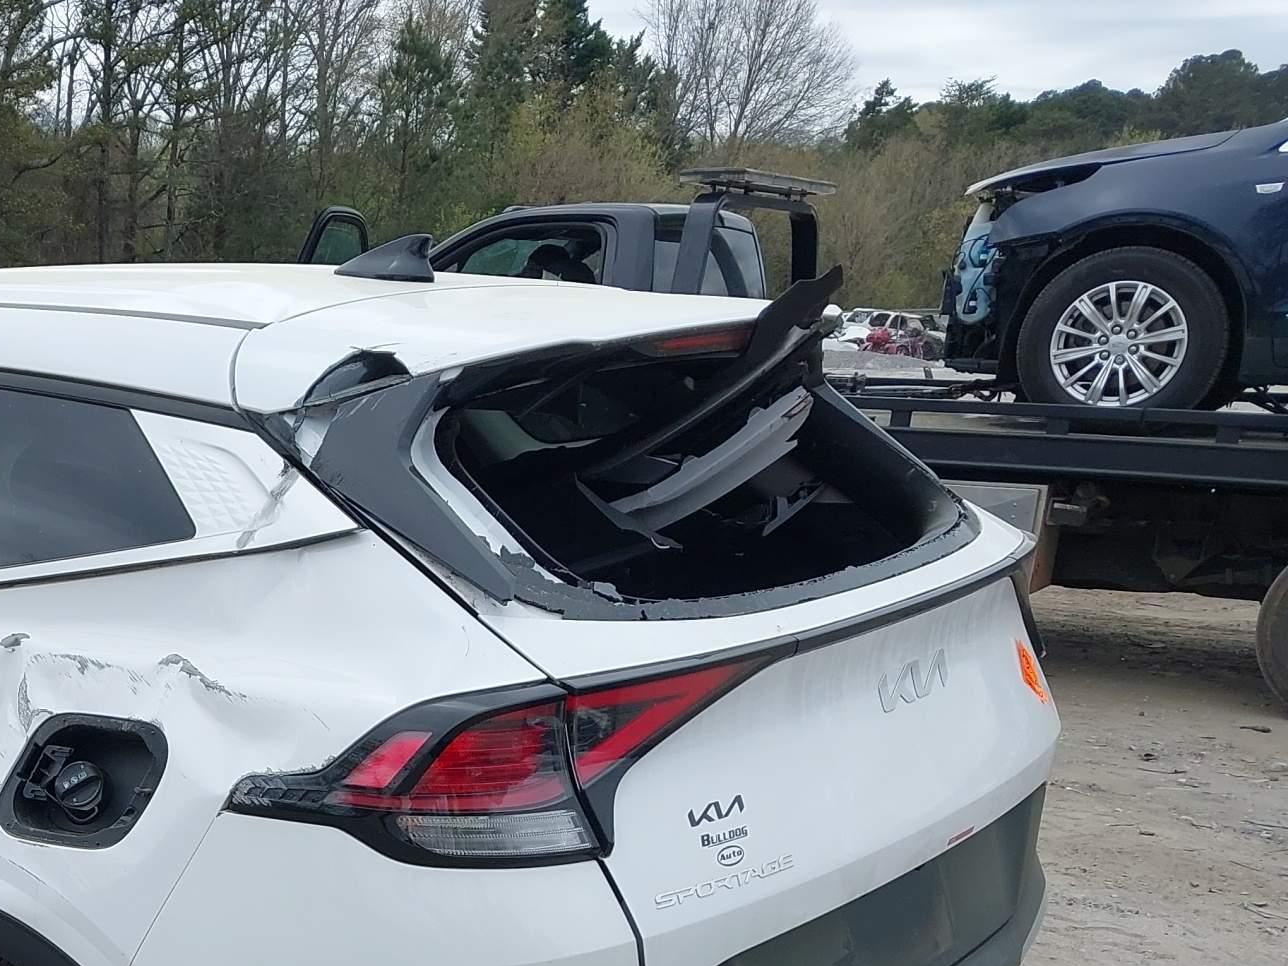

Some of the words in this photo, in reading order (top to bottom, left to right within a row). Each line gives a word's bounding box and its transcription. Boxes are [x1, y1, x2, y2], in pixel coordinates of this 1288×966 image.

[687, 794, 745, 828] KIA
[719, 849, 743, 862] Auto
[654, 854, 795, 910] SPORTAGE
